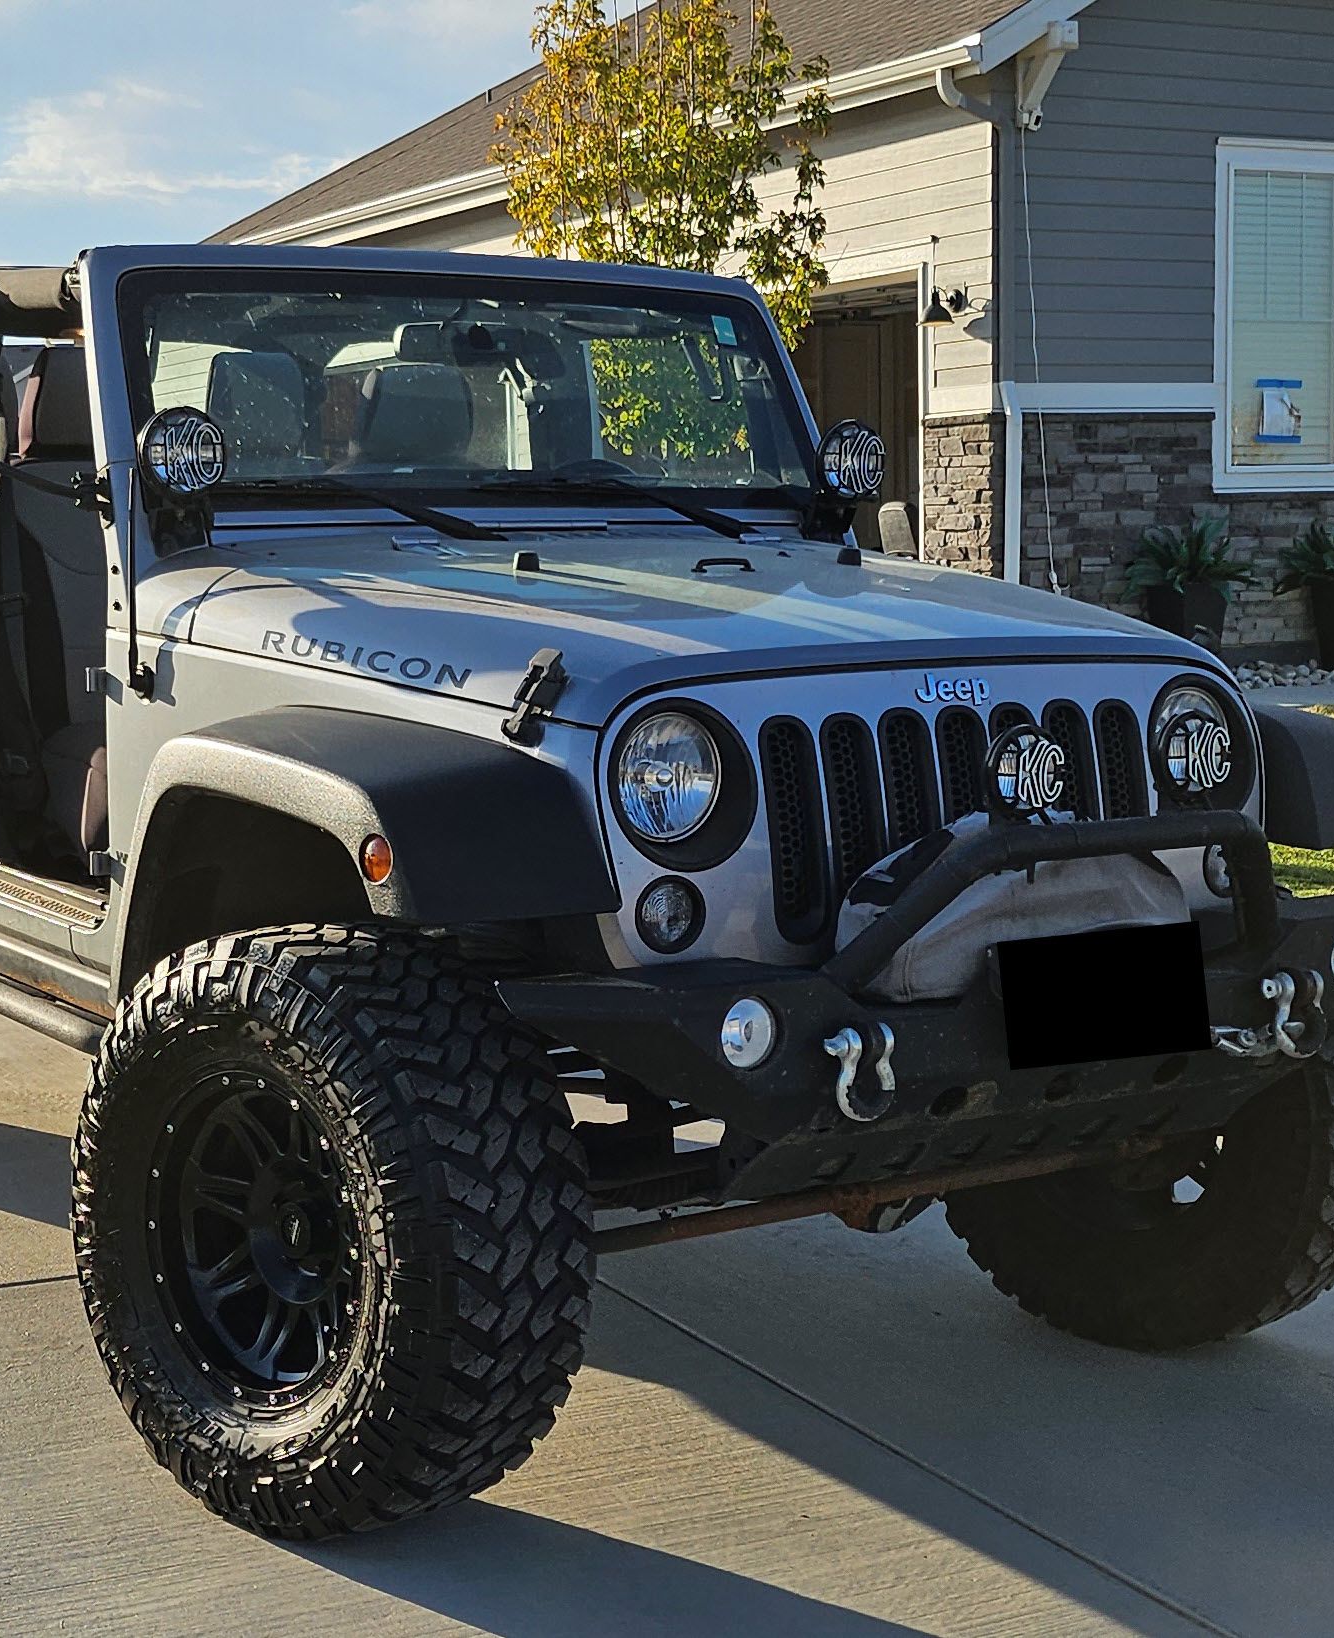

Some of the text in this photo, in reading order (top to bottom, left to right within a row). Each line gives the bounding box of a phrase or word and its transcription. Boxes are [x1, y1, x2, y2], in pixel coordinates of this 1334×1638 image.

[166, 417, 222, 489] KC
[840, 431, 885, 493] KC
[261, 630, 472, 689] RUBICON
[915, 673, 990, 706] Jeep
[1018, 740, 1065, 807] KC
[1187, 722, 1231, 787] KC
